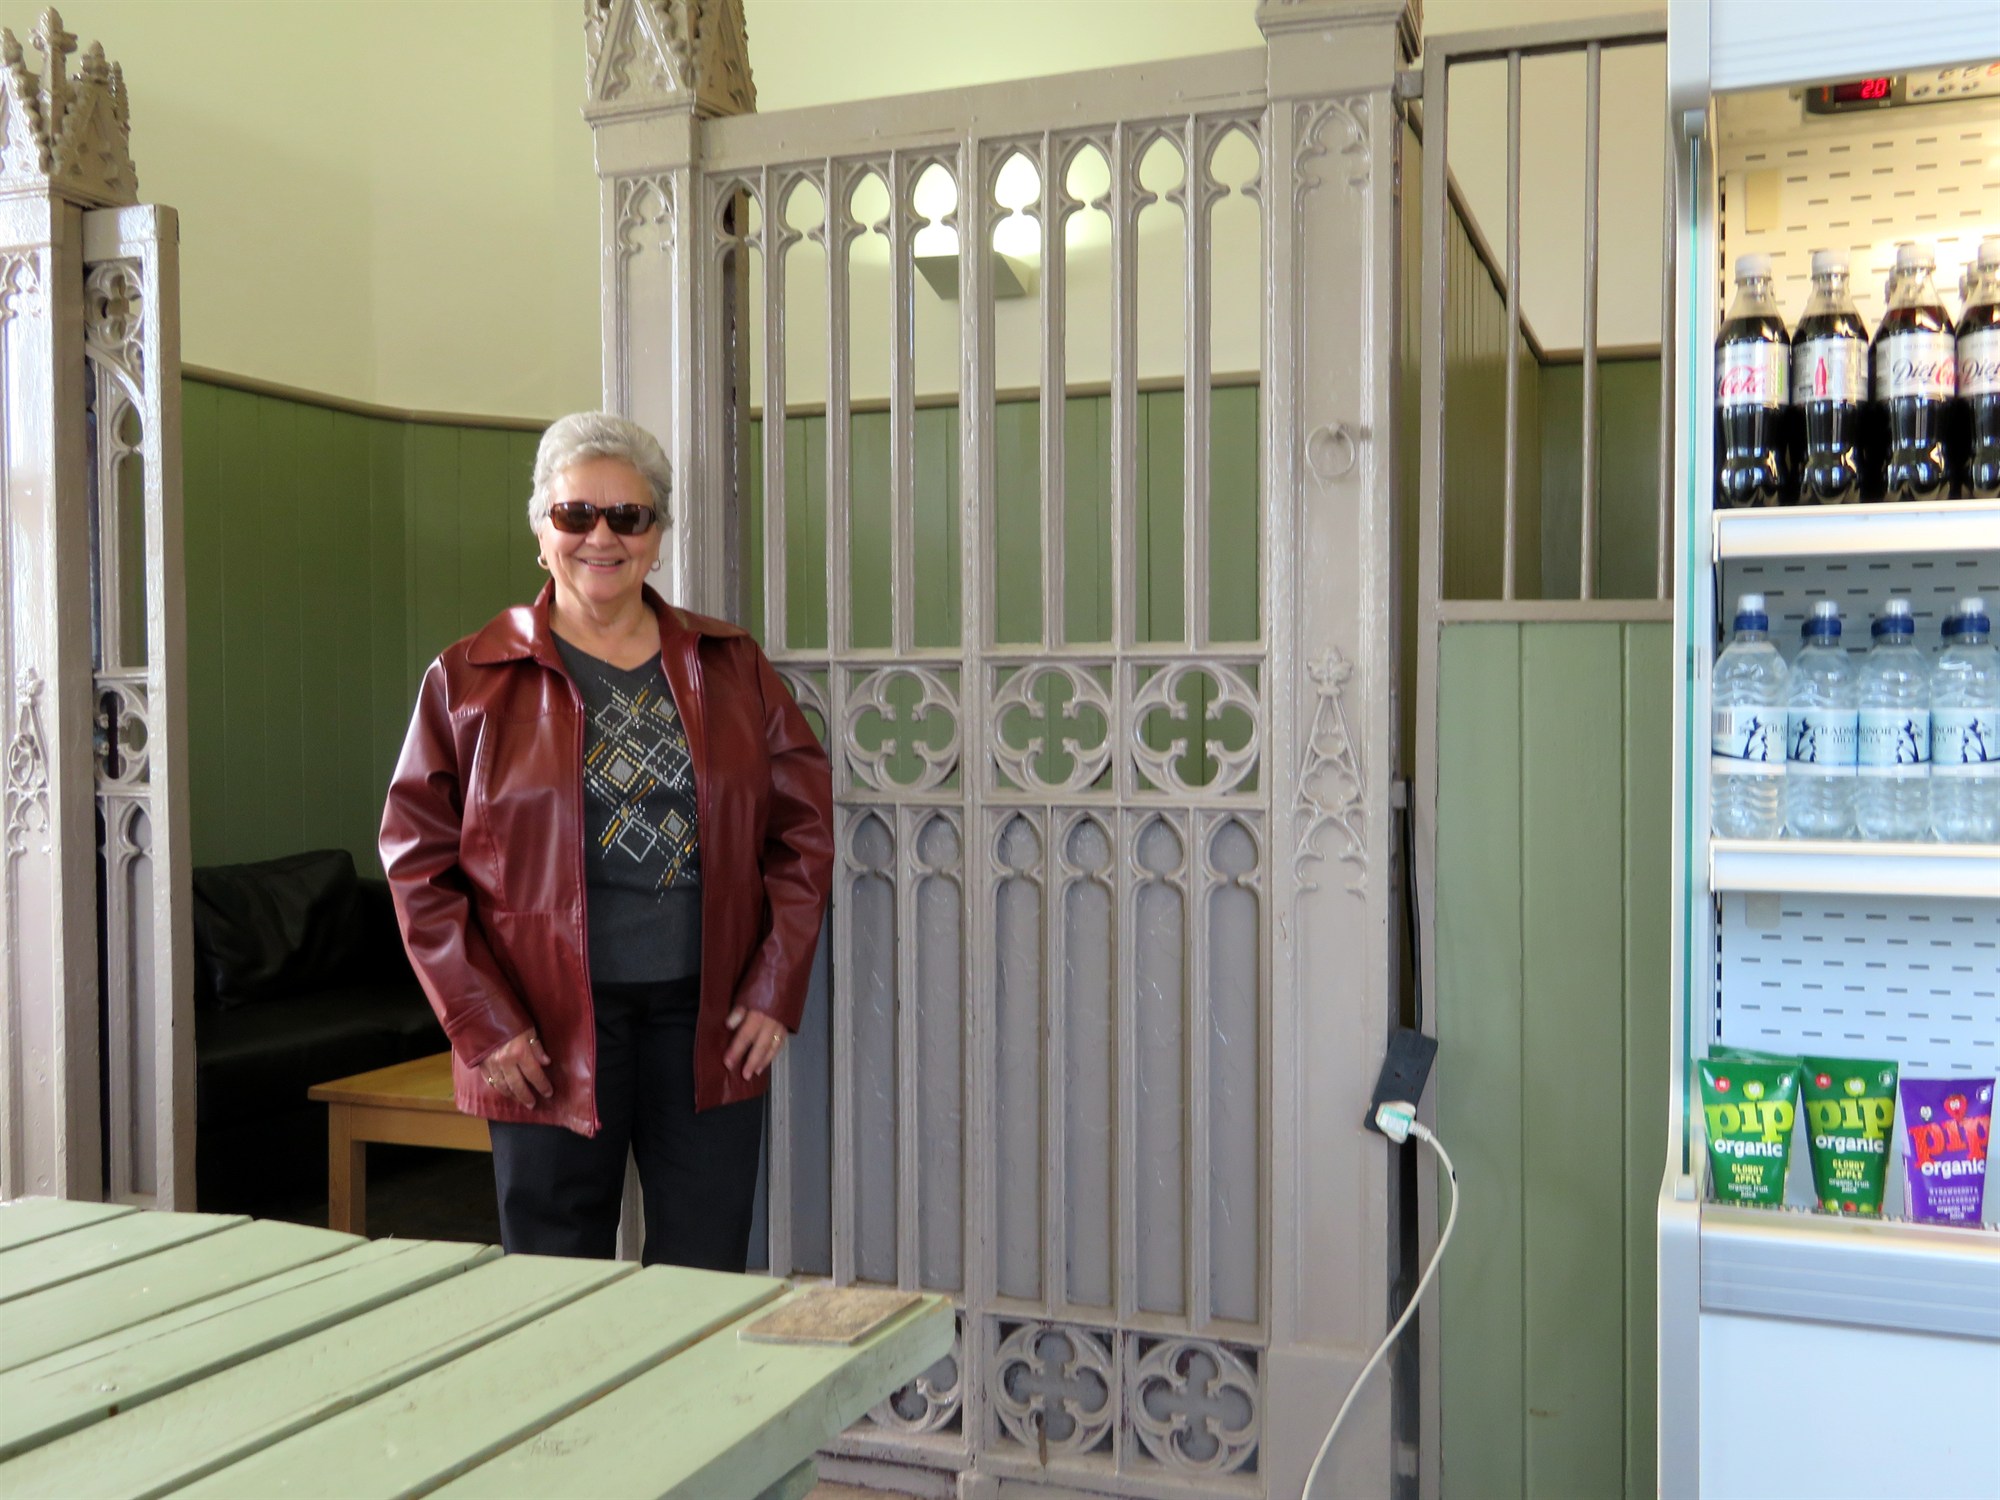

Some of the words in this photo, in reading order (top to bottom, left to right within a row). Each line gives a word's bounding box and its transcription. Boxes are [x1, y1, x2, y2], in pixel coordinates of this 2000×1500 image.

[1893, 357, 1937, 385] Diet
[1705, 1081, 1794, 1142] pip
[1806, 1078, 1894, 1139] pip
[1909, 1095, 1990, 1167] pip
[1714, 1138, 1783, 1158] organic
[1815, 1134, 1884, 1154] organic
[1731, 1163, 1764, 1176] CLOUDY
[1832, 1158, 1865, 1172] CLOUDY
[1836, 1169, 1863, 1181] APPLE
[1921, 1157, 1985, 1179] organic
[1735, 1174, 1762, 1185] APPLE
